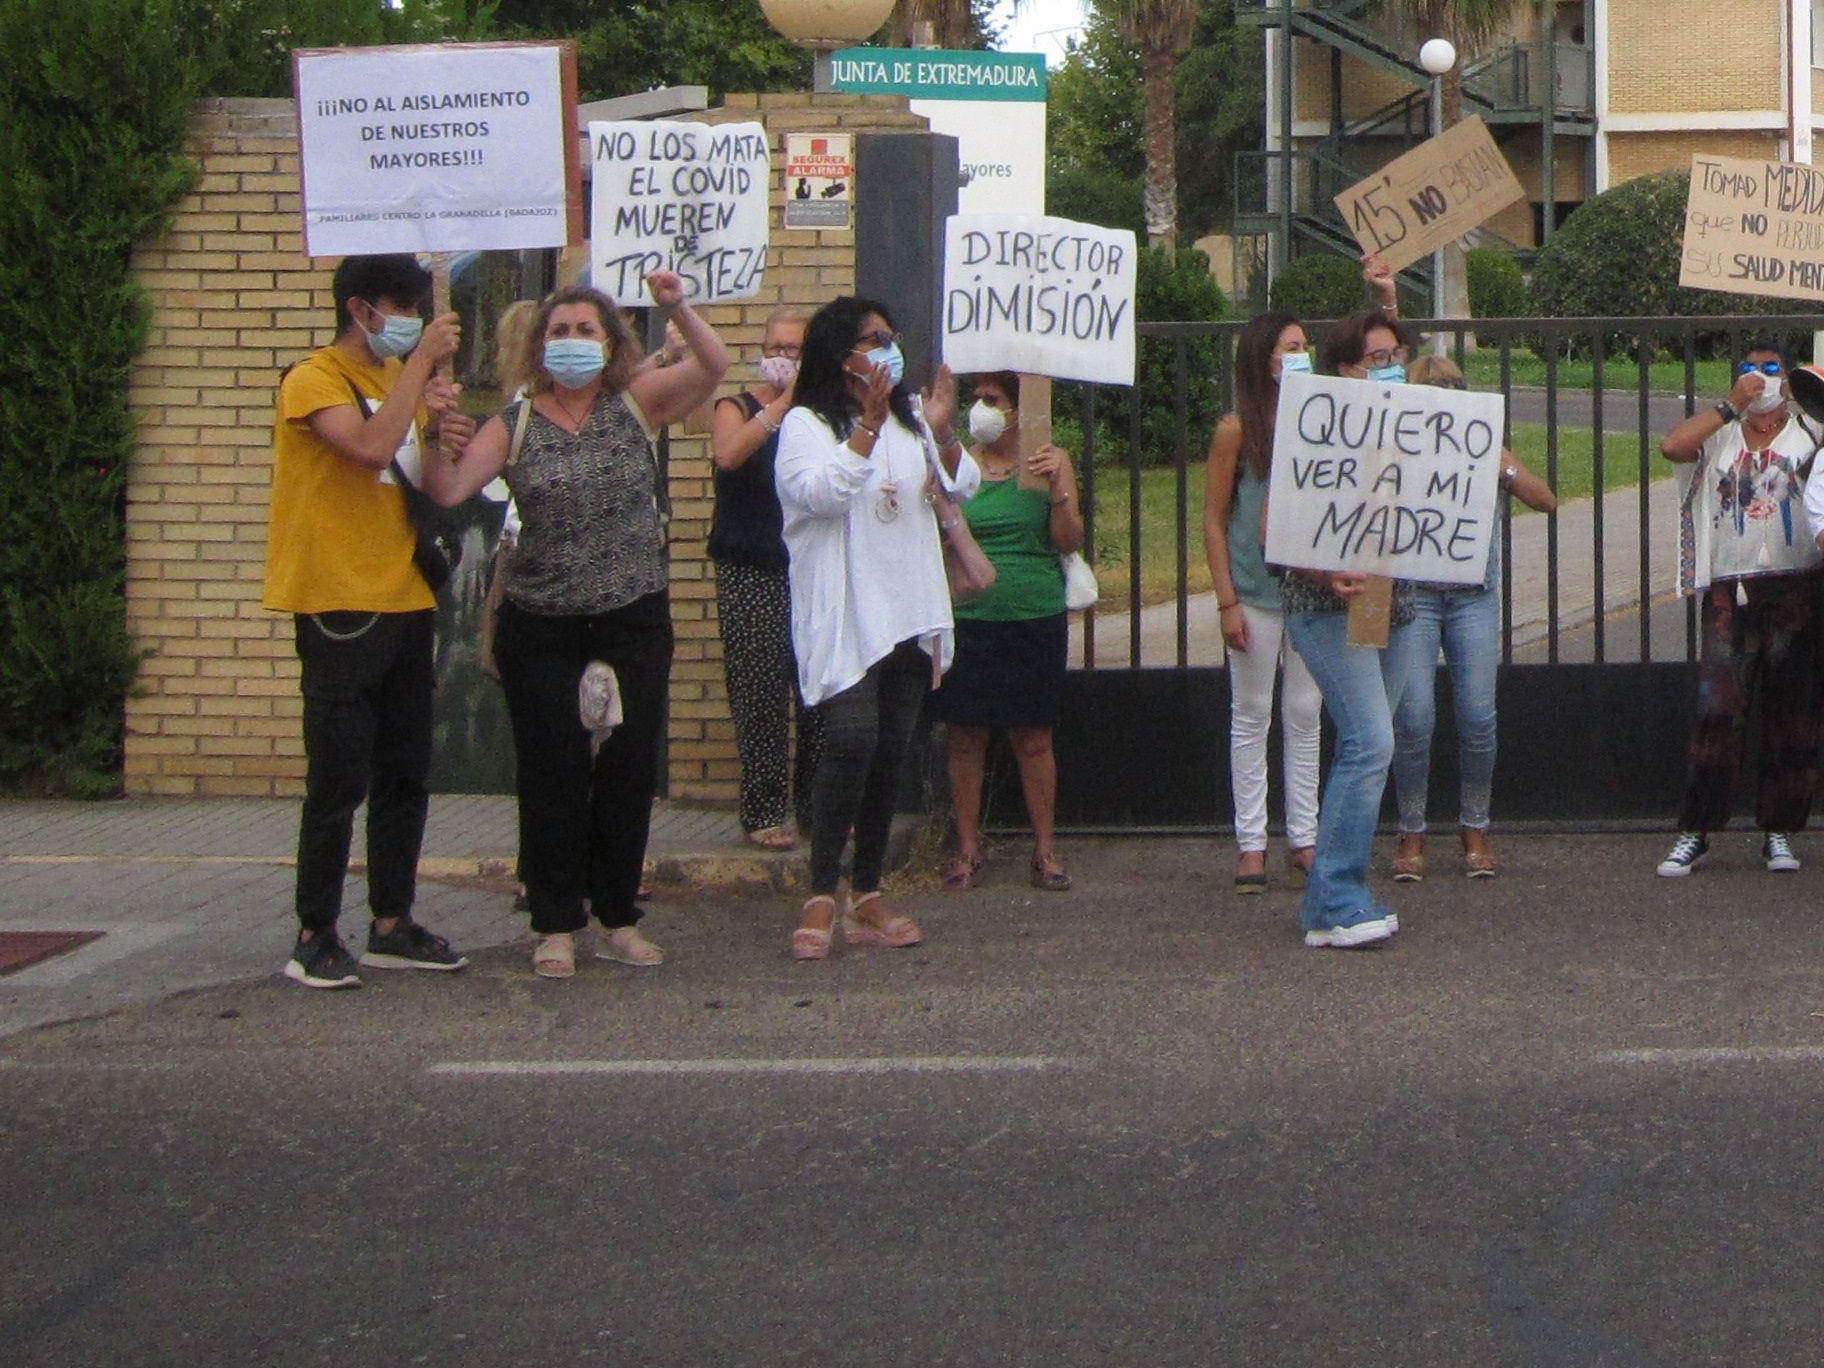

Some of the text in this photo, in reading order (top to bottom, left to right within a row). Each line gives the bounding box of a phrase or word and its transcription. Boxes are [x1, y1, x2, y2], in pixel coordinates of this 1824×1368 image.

[831, 60, 1039, 87] JUNTA DE EXTREMADURA
[317, 90, 530, 117] ¡¡¡NO AL AISLAMIENTO
[361, 121, 490, 141] DE NUESTROS
[370, 149, 484, 170] MAYORES!!!
[597, 130, 768, 164] NO LOS MATA
[793, 155, 846, 164] SEGUREX
[629, 163, 751, 196] EL COVID
[793, 166, 845, 176] ALARMA
[962, 161, 1012, 182] ayores
[1695, 161, 1757, 198] TOMAD
[615, 202, 736, 238] MUEREN
[1408, 185, 1447, 226] NO
[1741, 212, 1768, 236] NO
[674, 235, 699, 252] DE
[961, 231, 1124, 275] DIRECTOR
[1728, 253, 1785, 282] SALUD
[948, 274, 1128, 341] DIMISIÓN
[1298, 390, 1493, 459] QUIERO
[1293, 456, 1476, 508] VER A MI
[1312, 501, 1478, 562] MADRE
